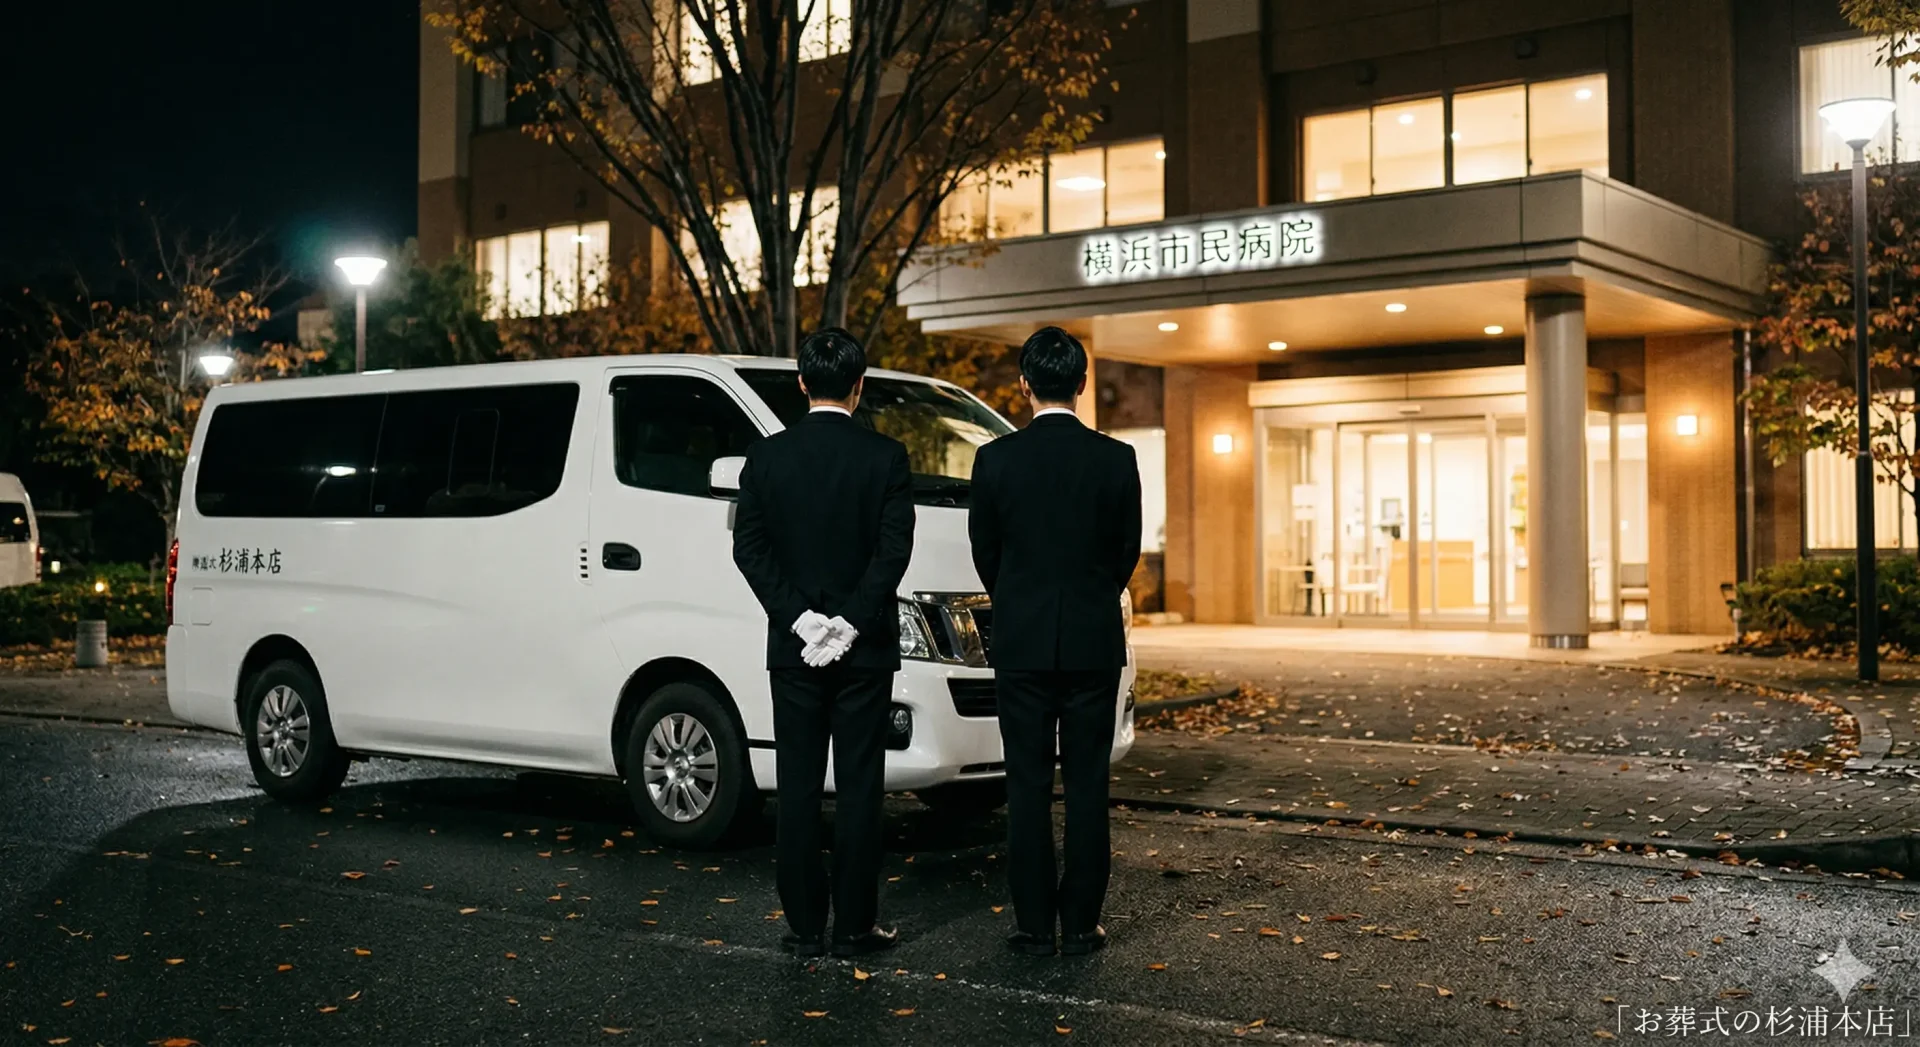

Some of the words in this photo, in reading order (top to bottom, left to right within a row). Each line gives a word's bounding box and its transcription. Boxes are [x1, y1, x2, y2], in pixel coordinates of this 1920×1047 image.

[1084, 219, 1314, 277] 横浜市民病院
[219, 547, 282, 575] 杉浦本店
